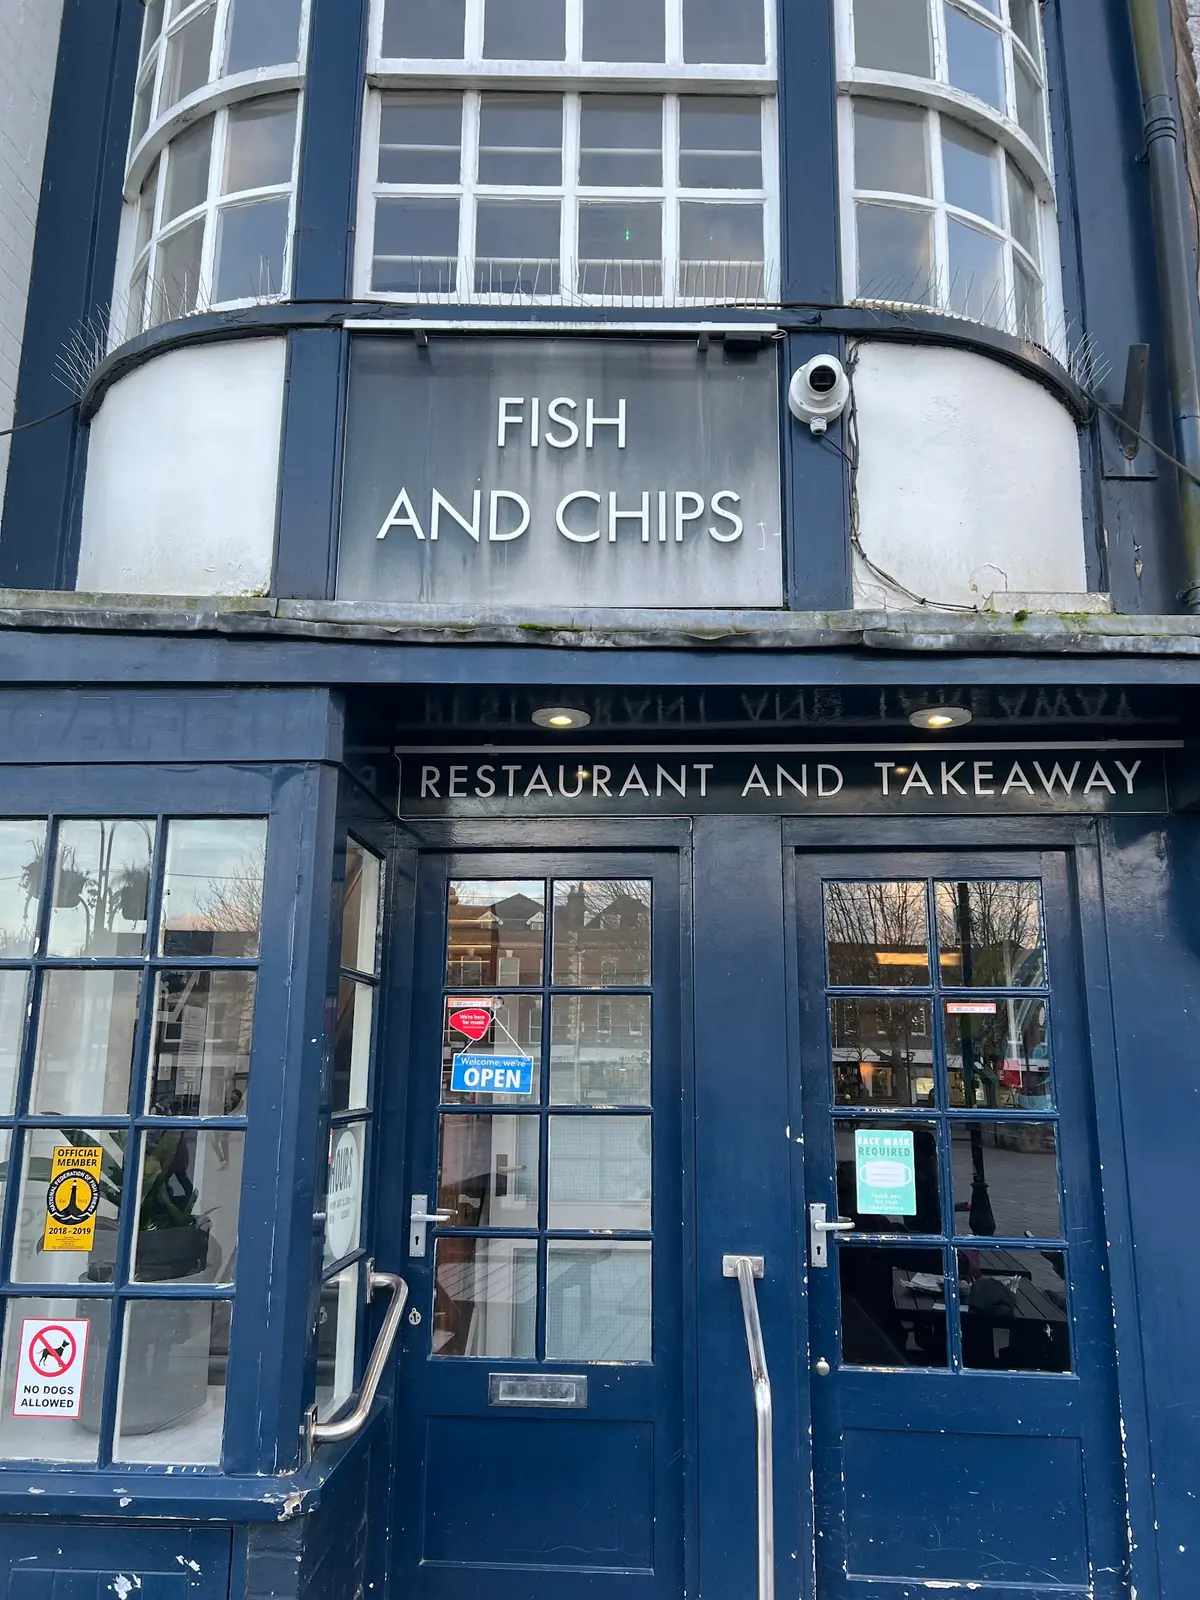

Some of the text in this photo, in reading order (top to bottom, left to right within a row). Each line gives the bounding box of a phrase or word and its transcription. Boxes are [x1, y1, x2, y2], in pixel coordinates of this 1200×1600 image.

[497, 396, 627, 449] FISH
[376, 486, 744, 543] AND CHIPS
[420, 760, 1142, 799] RESTAURANT AND TAKEAWAY
[461, 1057, 527, 1068] Welcome, we're
[464, 1068, 521, 1088] OPEN
[858, 1136, 911, 1147] FACE MASK
[57, 1149, 99, 1157] OFFICIAL
[858, 1146, 911, 1157] REQUIRED
[57, 1158, 97, 1167] MEMBER
[48, 1186, 57, 1213] NATIONAL
[55, 1170, 86, 1186] FEDERATION
[84, 1174, 92, 1182] OF
[89, 1179, 98, 1193] FISH
[48, 1227, 68, 1235] 2018
[72, 1227, 91, 1235] 2019
[23, 1385, 74, 1395] NO DOGS
[20, 1398, 74, 1408] ALLOWED
